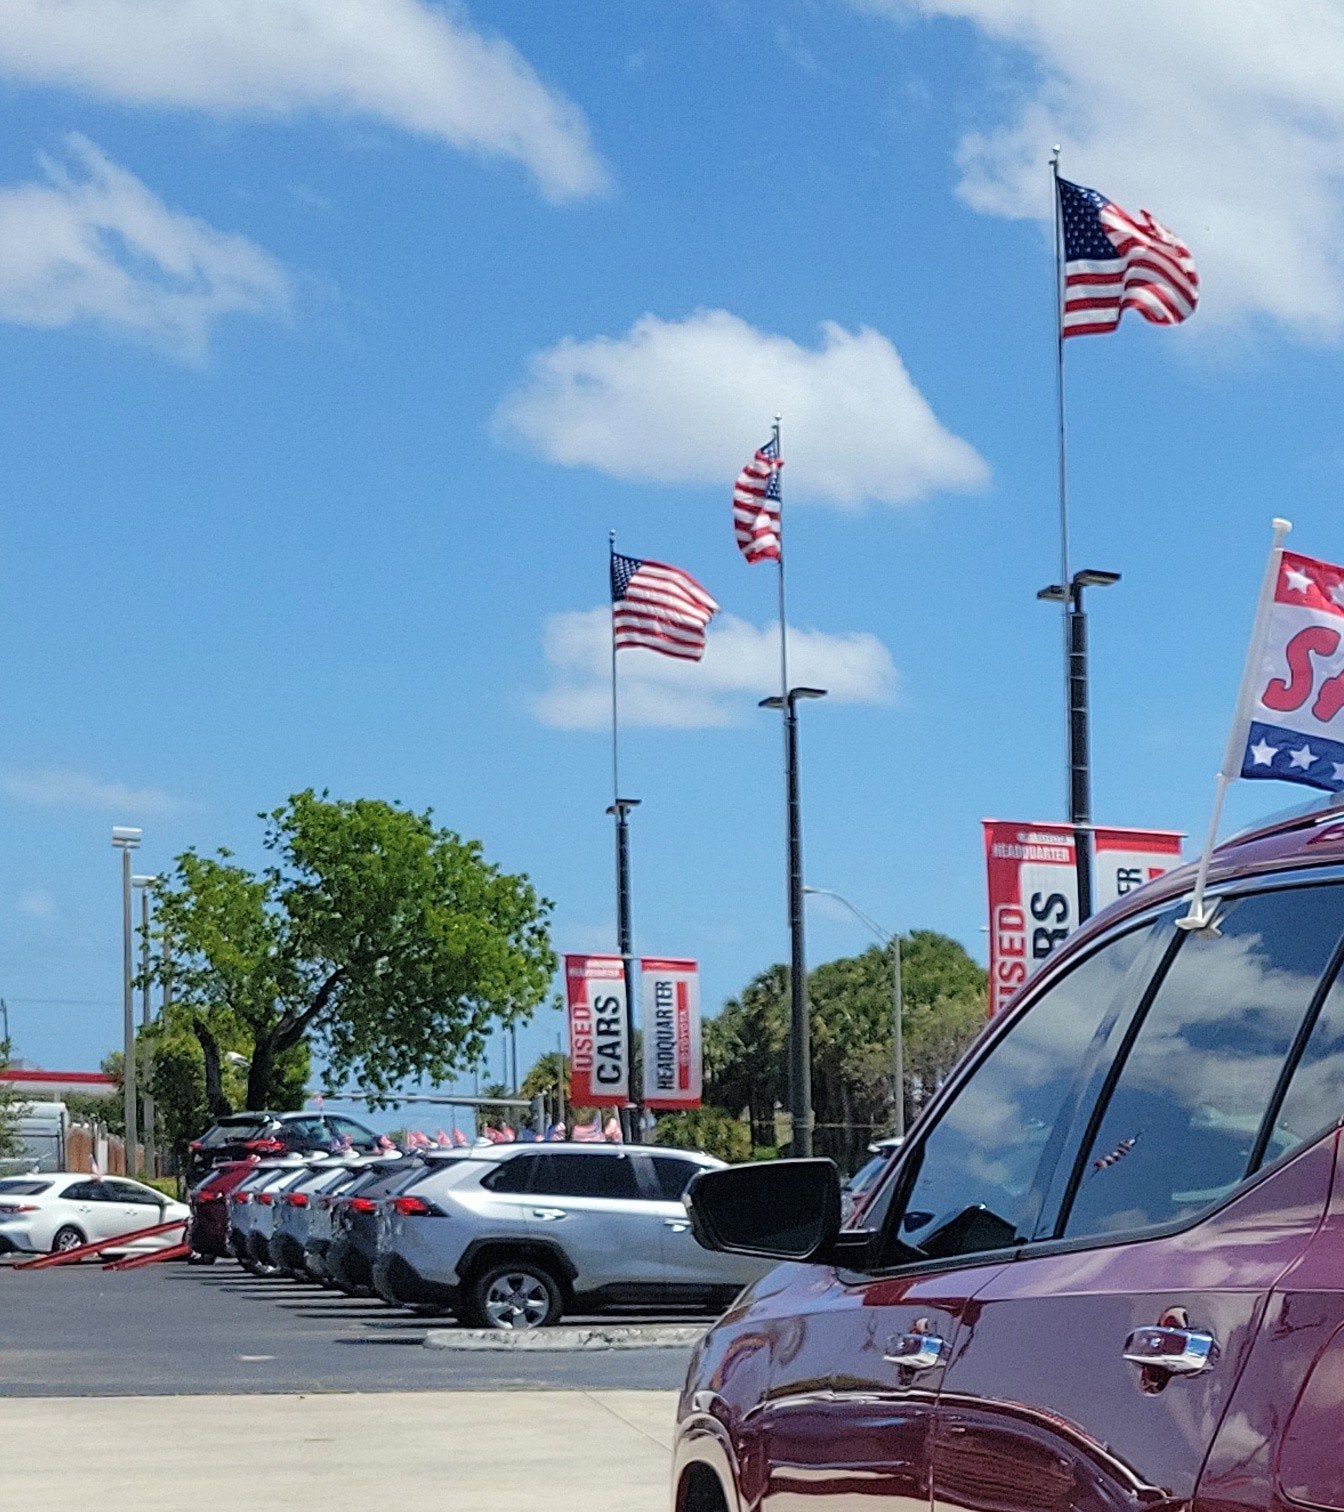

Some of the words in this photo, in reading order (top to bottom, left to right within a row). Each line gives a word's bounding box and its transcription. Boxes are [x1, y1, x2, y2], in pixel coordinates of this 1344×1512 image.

[573, 1006, 593, 1069] USED
[595, 995, 622, 1084] CARS
[656, 981, 677, 1090] HEADQUARTER
